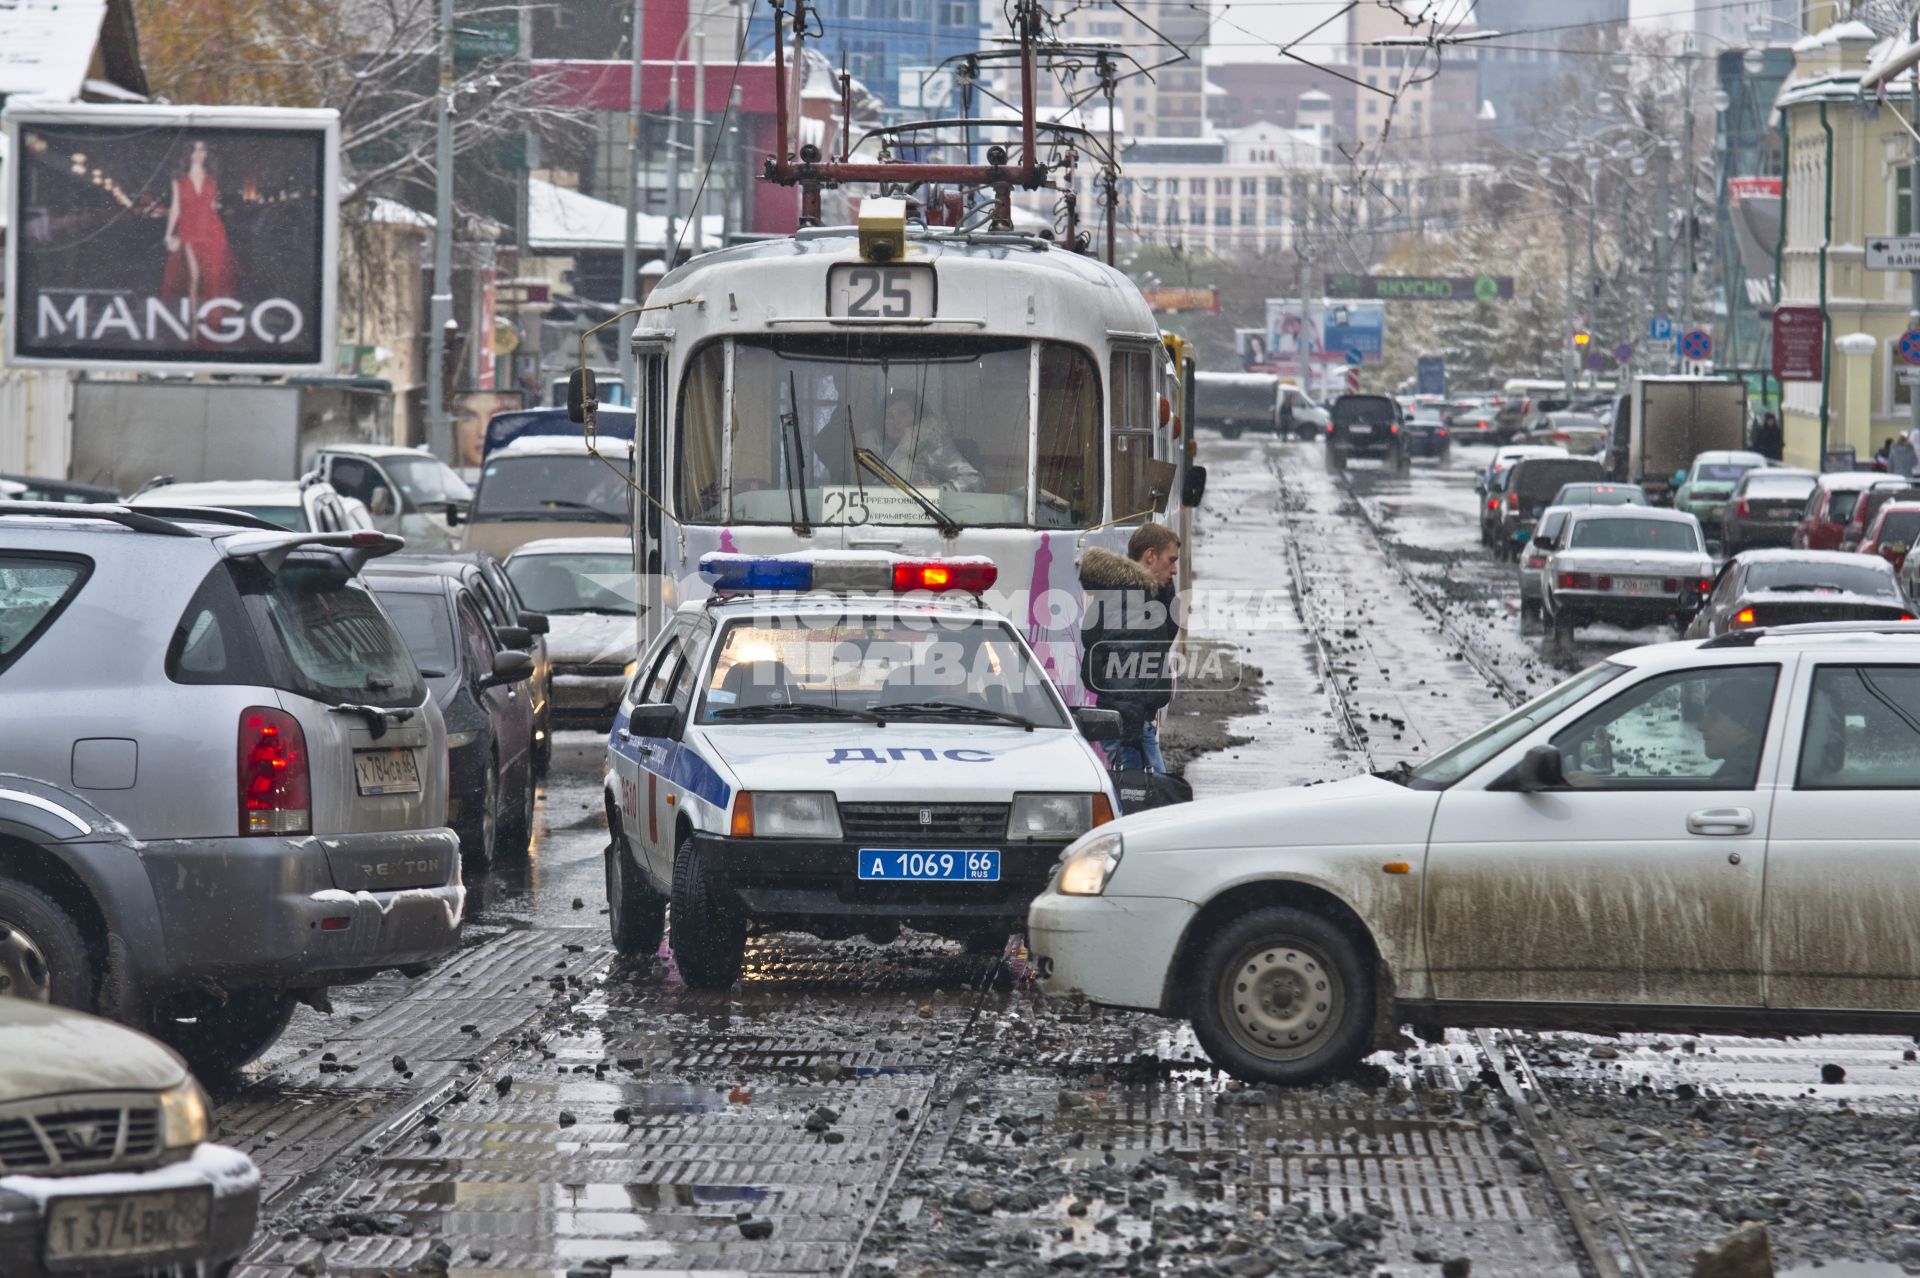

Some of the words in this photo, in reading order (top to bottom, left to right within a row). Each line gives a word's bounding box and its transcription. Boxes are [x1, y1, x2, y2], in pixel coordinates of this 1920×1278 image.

[848, 270, 912, 317] 25
[1376, 279, 1453, 297] ВКУСНО
[37, 295, 303, 344] MANGO
[824, 491, 870, 525] 25
[826, 747, 995, 764] ДПС
[896, 854, 954, 876] 1069
[968, 853, 992, 870] 66
[971, 870, 989, 878] RUS
